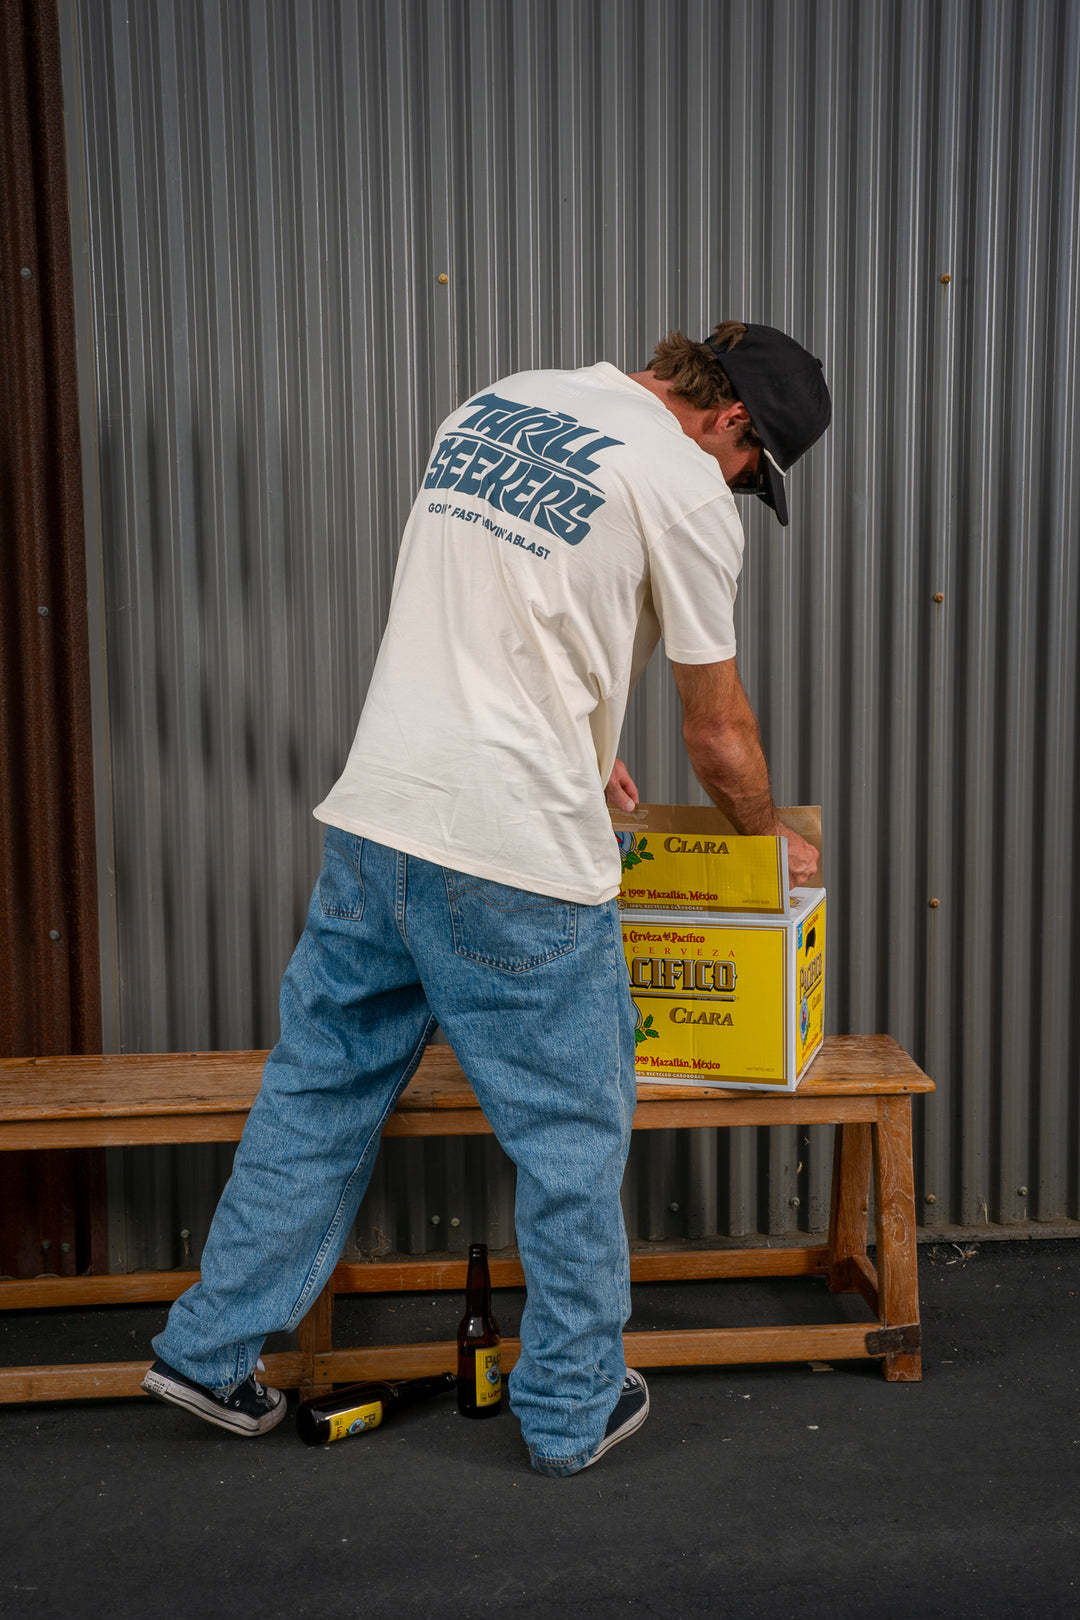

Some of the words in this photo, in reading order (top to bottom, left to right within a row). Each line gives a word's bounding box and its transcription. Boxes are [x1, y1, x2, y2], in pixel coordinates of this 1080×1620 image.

[458, 393, 626, 475] THRILL
[424, 437, 606, 546] SEEKERS
[451, 507, 482, 523] FAST
[505, 531, 513, 543] A
[513, 534, 551, 560] BLAST
[663, 836, 730, 855] CLARA
[632, 945, 735, 958] CERVEZA
[668, 1006, 735, 1027] CLARA
[634, 1055, 649, 1066] 900
